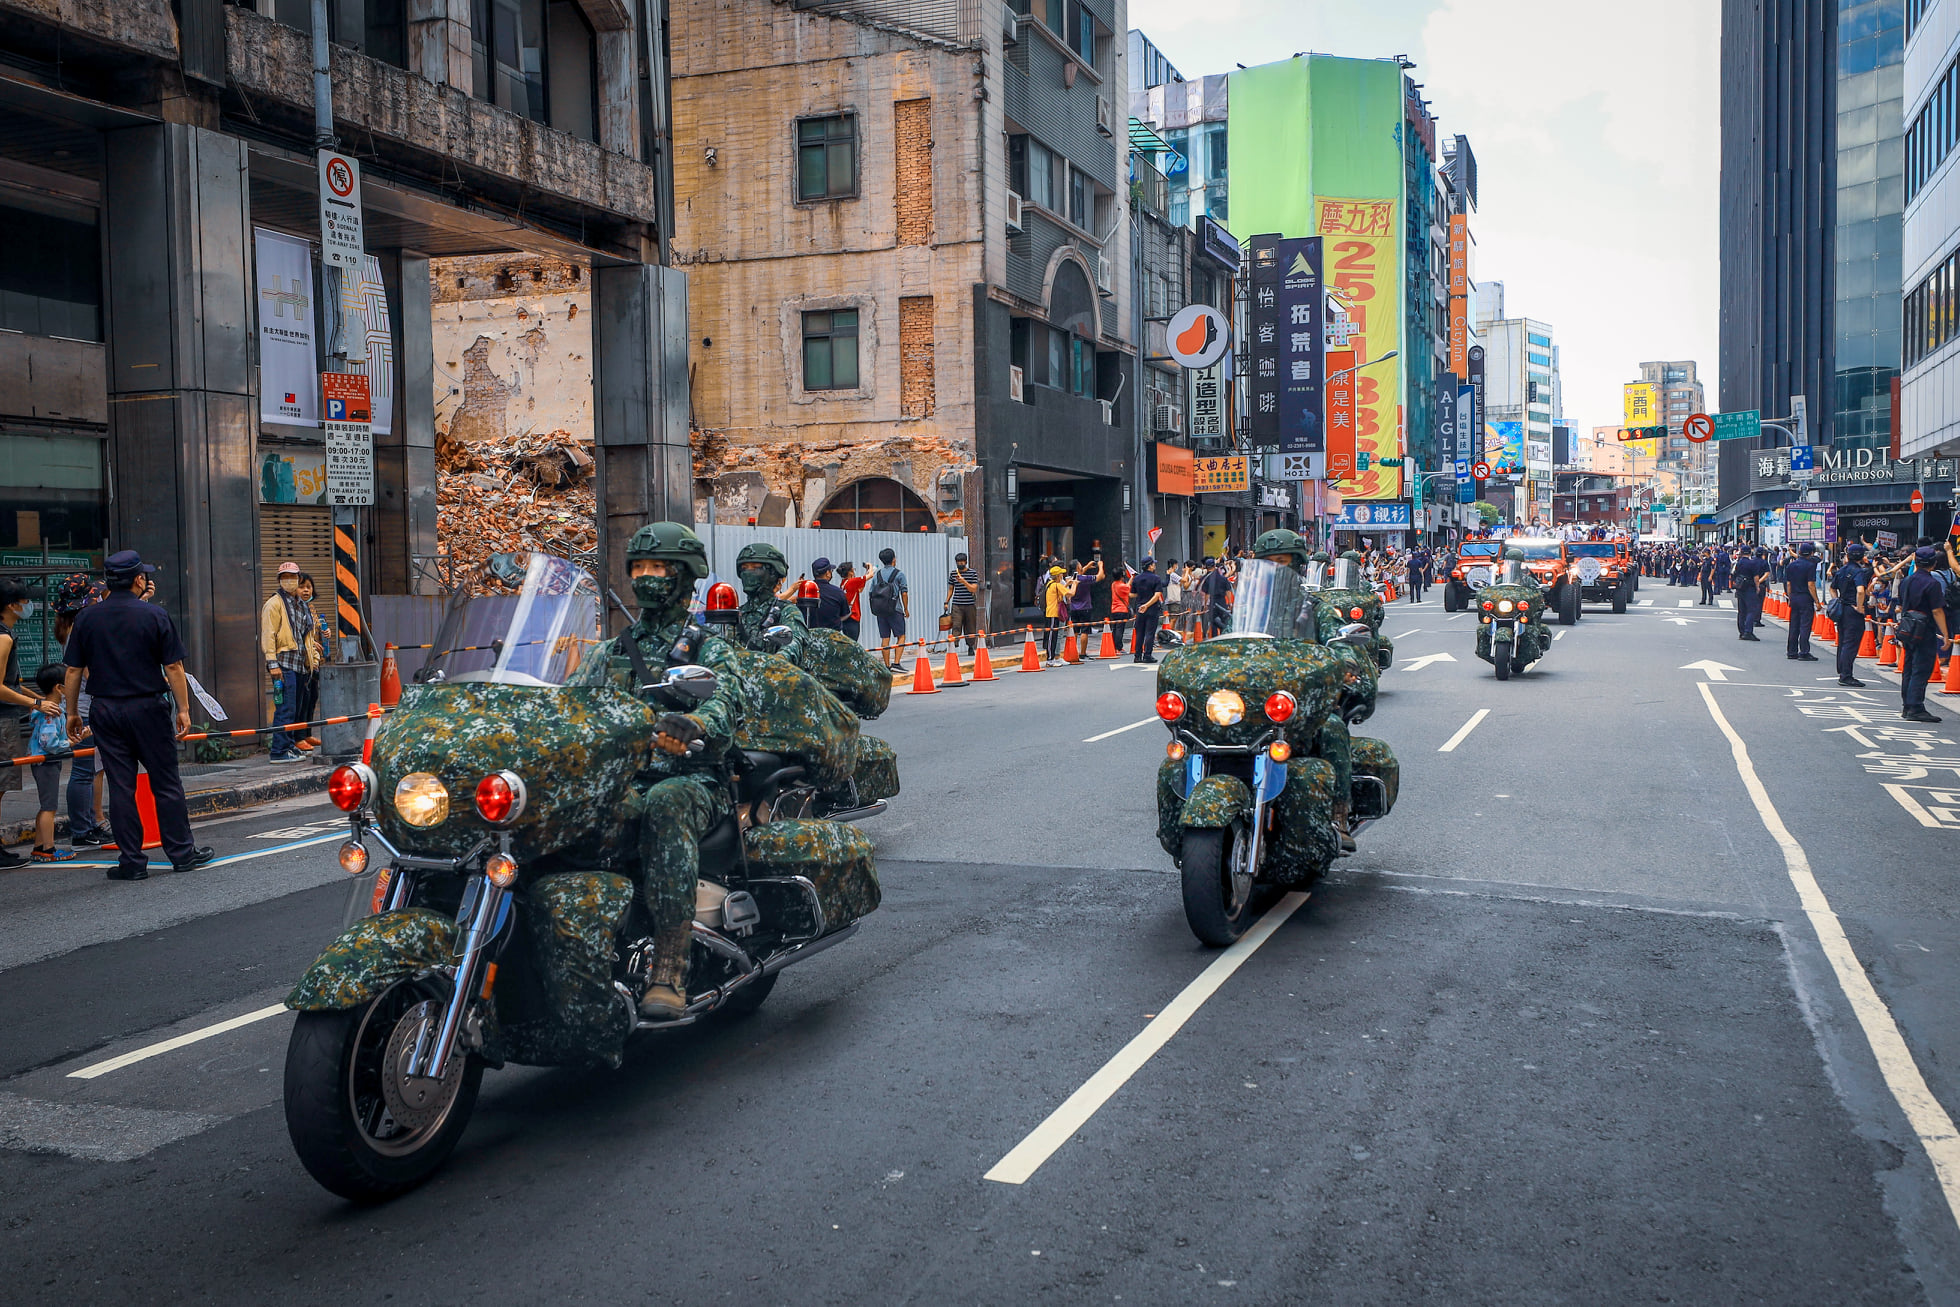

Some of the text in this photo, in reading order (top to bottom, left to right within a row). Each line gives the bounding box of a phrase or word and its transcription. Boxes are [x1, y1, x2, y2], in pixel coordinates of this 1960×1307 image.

[344, 255, 357, 264] 110
[1454, 223, 1464, 287] 新驛旅店
[1290, 304, 1311, 380] 拓荒者
[1452, 316, 1466, 362] CityInn
[1258, 287, 1275, 413] 怡客咖啡
[1333, 369, 1350, 429] 康是美
[1633, 396, 1647, 418] 西門
[330, 400, 342, 418] P
[1440, 391, 1454, 467] AIGLE
[1635, 429, 1641, 438] 9
[327, 446, 370, 456] 09:00-17:00
[1791, 448, 1802, 461] P
[1160, 463, 1186, 477] LOUISA COFFEE
[1194, 458, 1244, 472] 文曲居士
[1819, 469, 1894, 483] RICHARDSON
